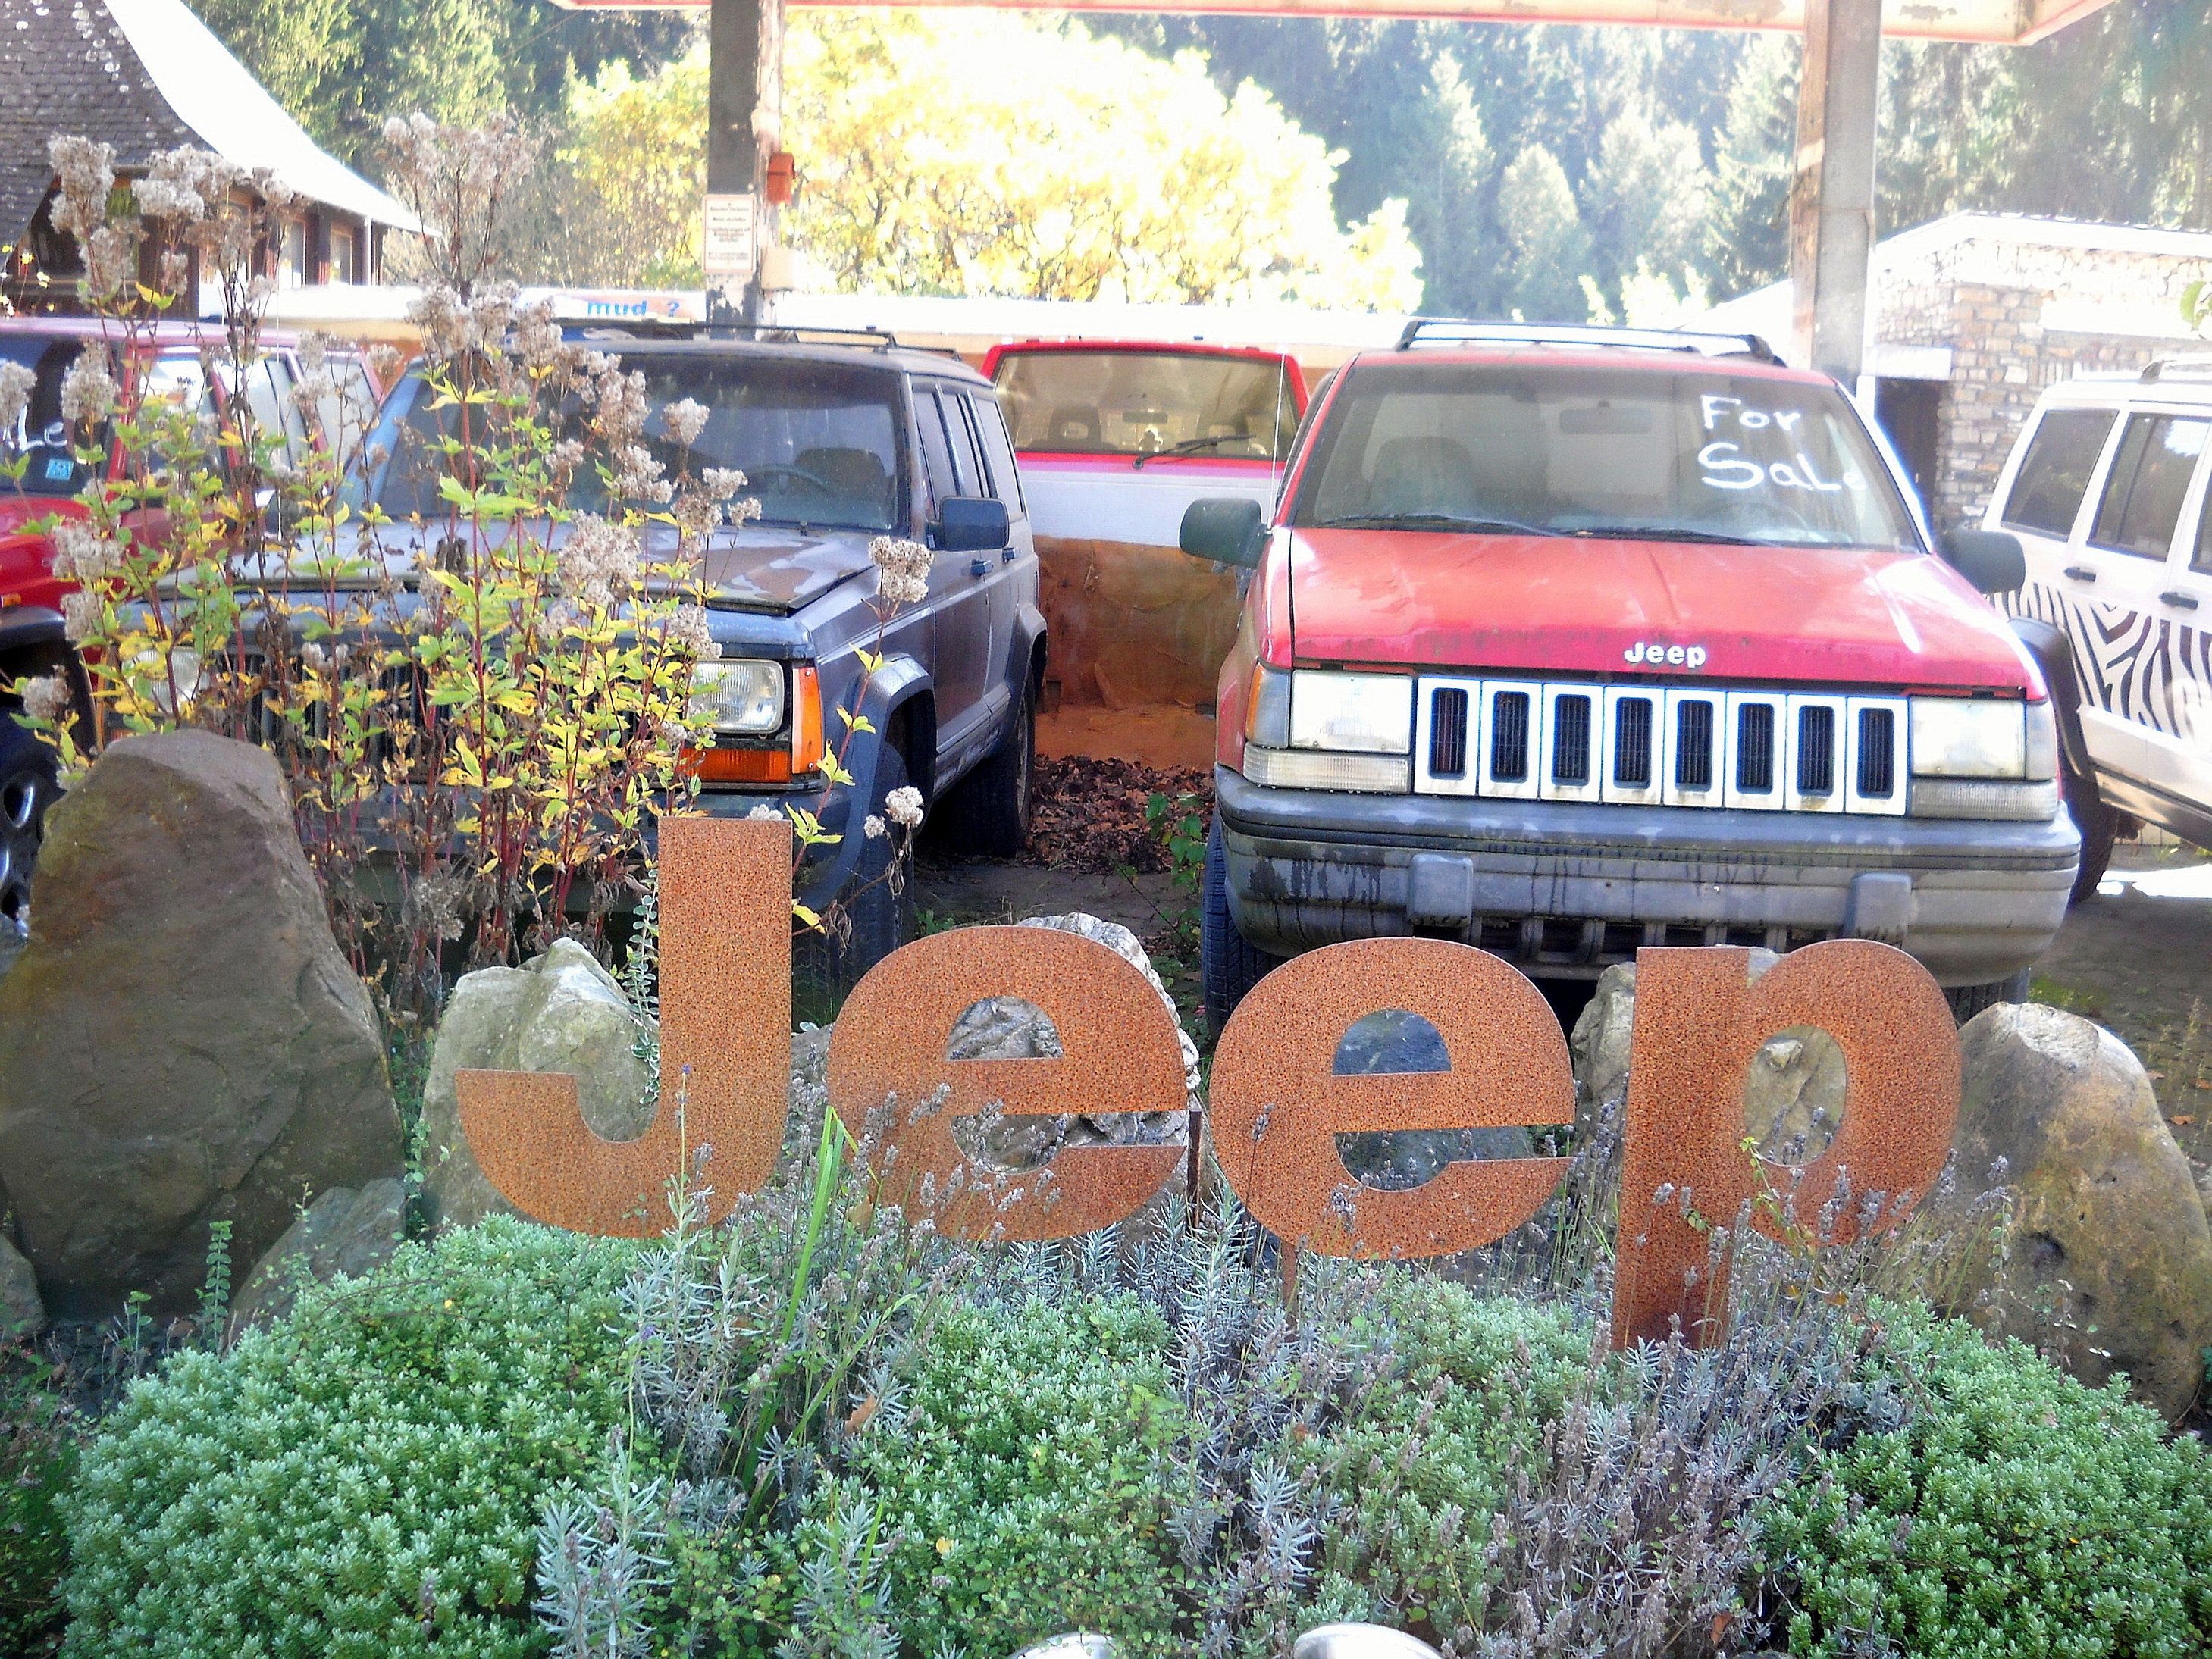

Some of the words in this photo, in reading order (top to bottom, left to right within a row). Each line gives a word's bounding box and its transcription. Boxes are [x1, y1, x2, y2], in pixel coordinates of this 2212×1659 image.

[587, 300, 647, 316] mud
[666, 301, 680, 317] ?
[1701, 395, 1801, 430] For
[1624, 642, 1706, 668] Jeep
[455, 817, 1962, 1349] Jeep
